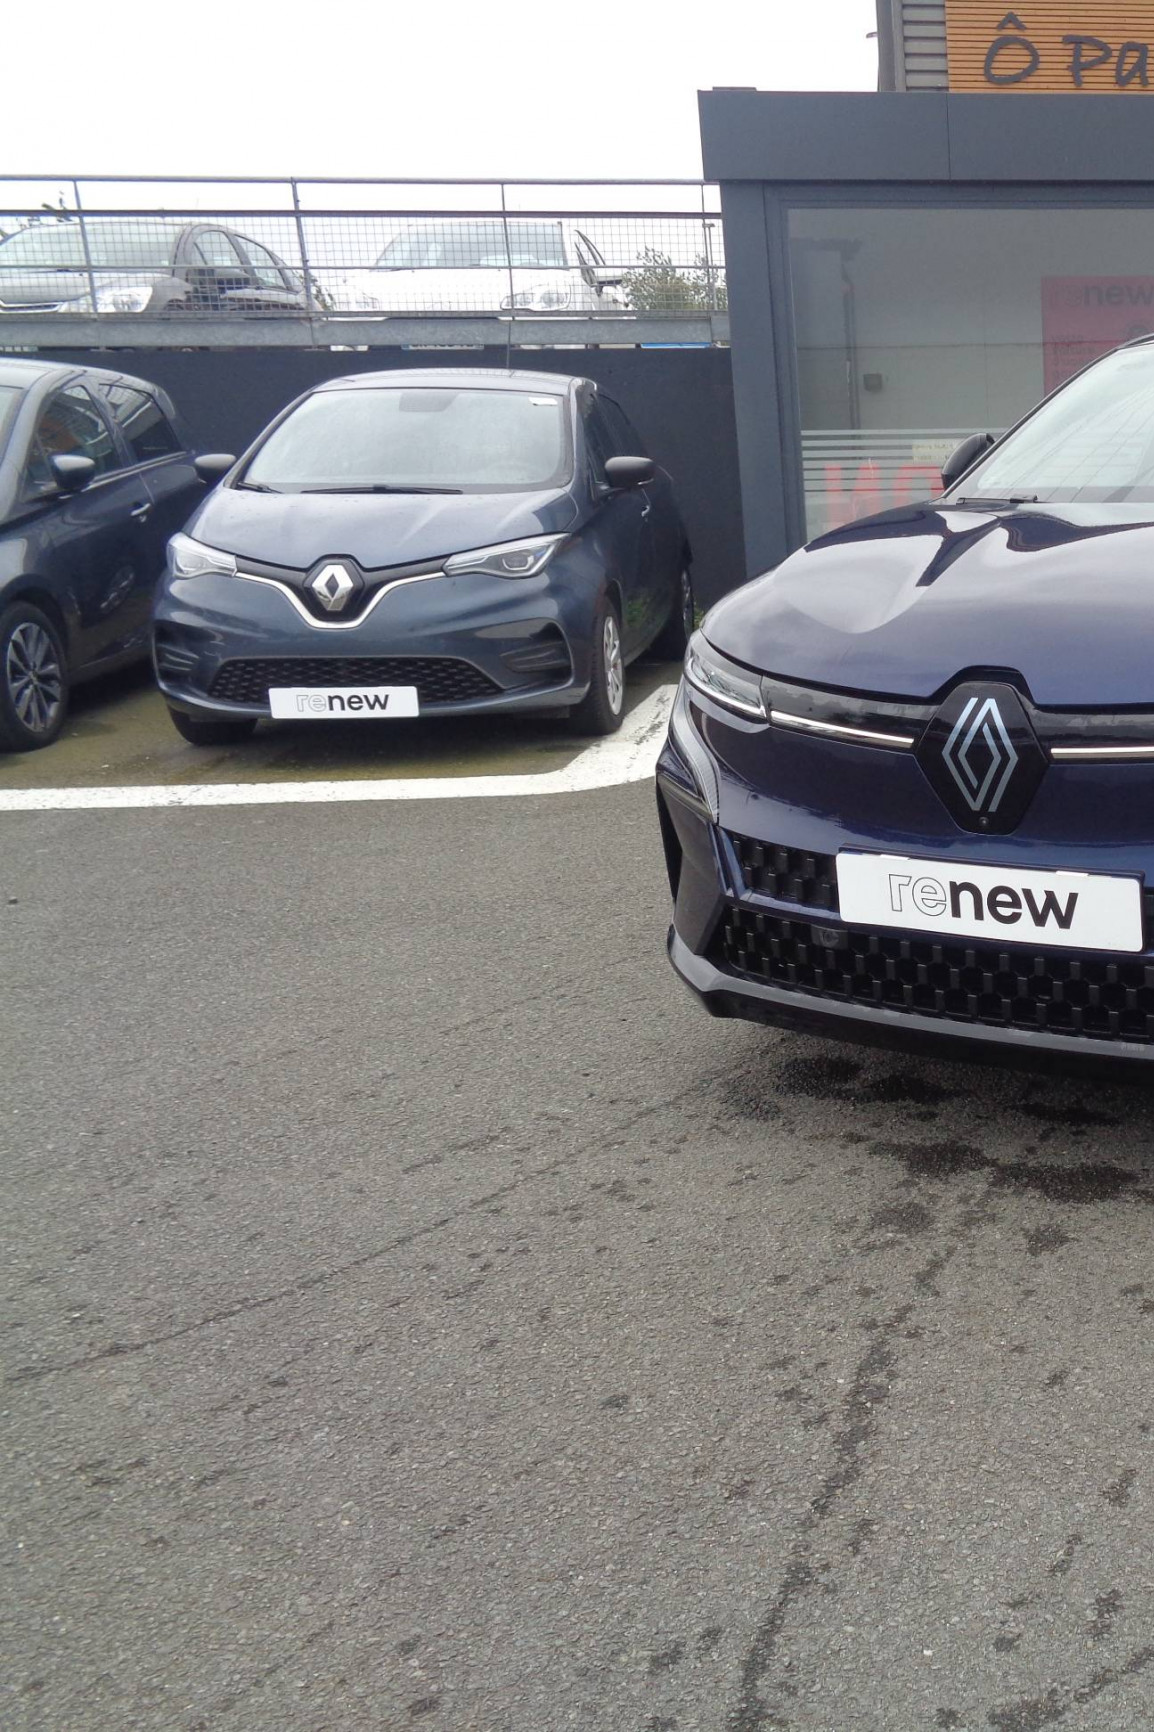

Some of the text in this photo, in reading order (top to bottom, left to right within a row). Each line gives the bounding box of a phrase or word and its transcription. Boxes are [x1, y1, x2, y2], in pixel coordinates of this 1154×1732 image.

[984, 12, 1040, 85] Ô
[296, 694, 390, 712] renew
[888, 873, 1079, 930] renew
